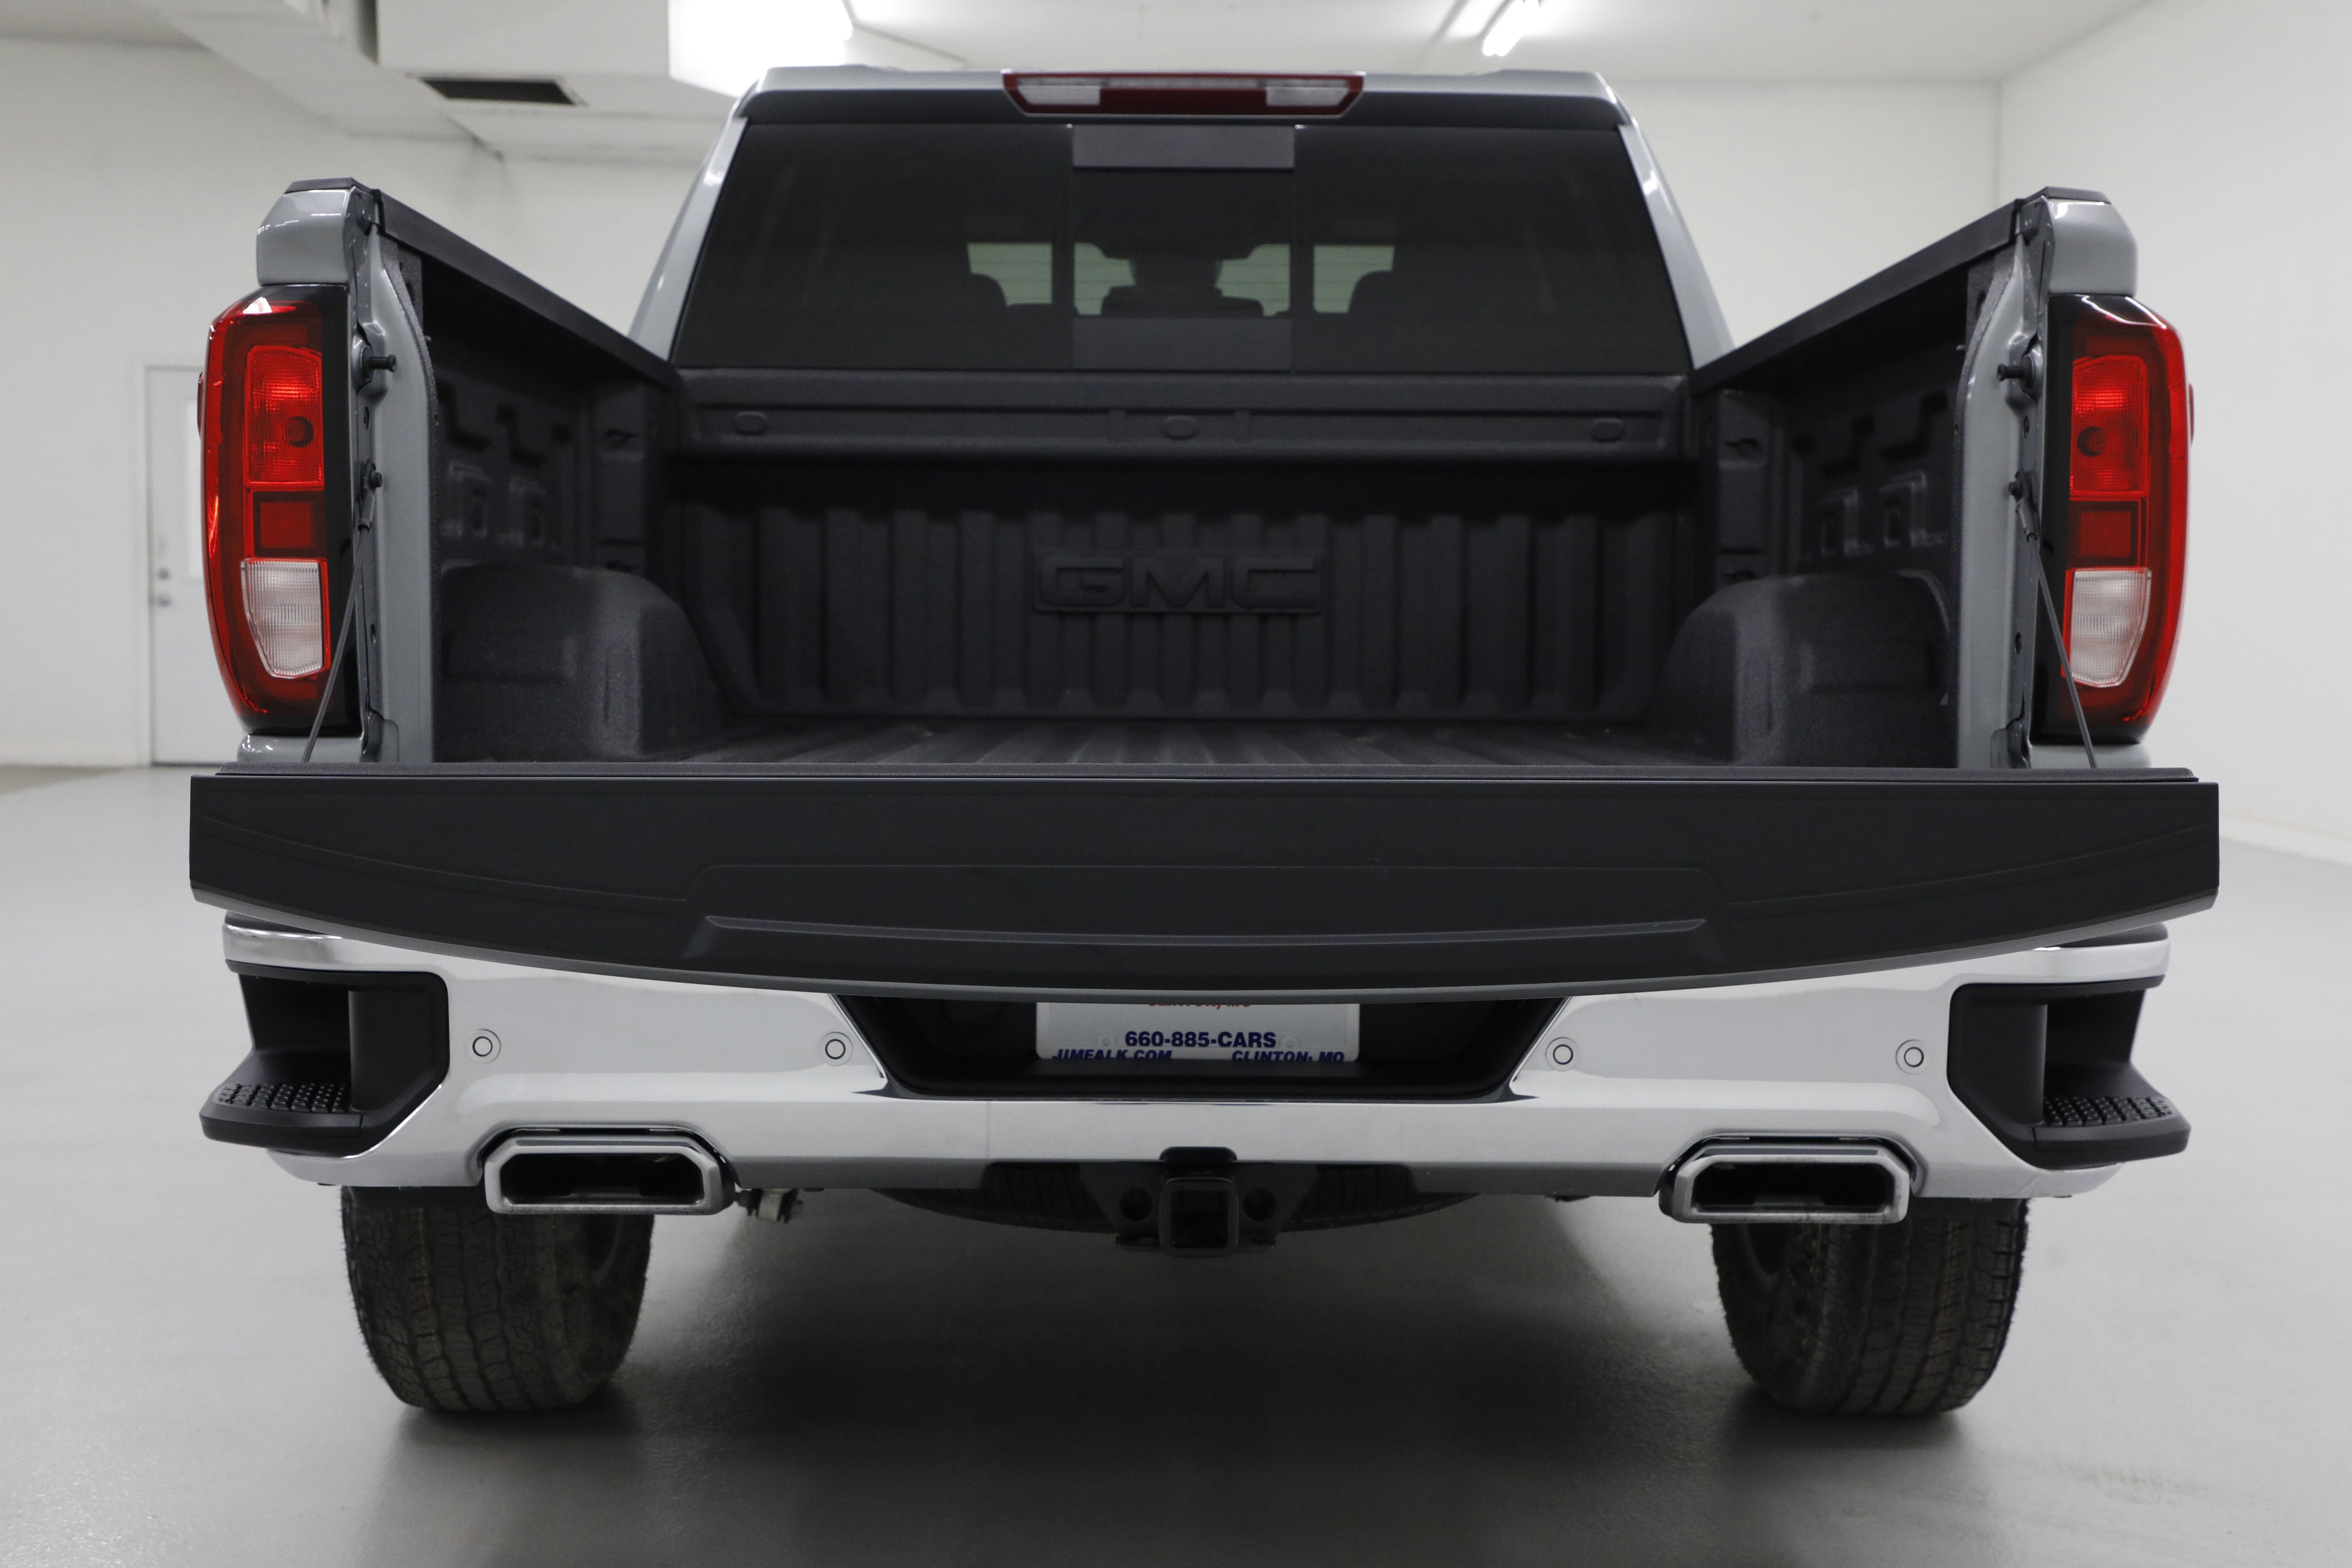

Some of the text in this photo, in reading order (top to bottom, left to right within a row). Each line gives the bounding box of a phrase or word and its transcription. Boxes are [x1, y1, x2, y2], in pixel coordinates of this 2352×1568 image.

[1040, 555, 1316, 608] GMC
[1125, 1031, 1276, 1048] 660-885-CARS
[1052, 1048, 1172, 1060] JIMFALKCOM
[1319, 1051, 1345, 1062] MO
